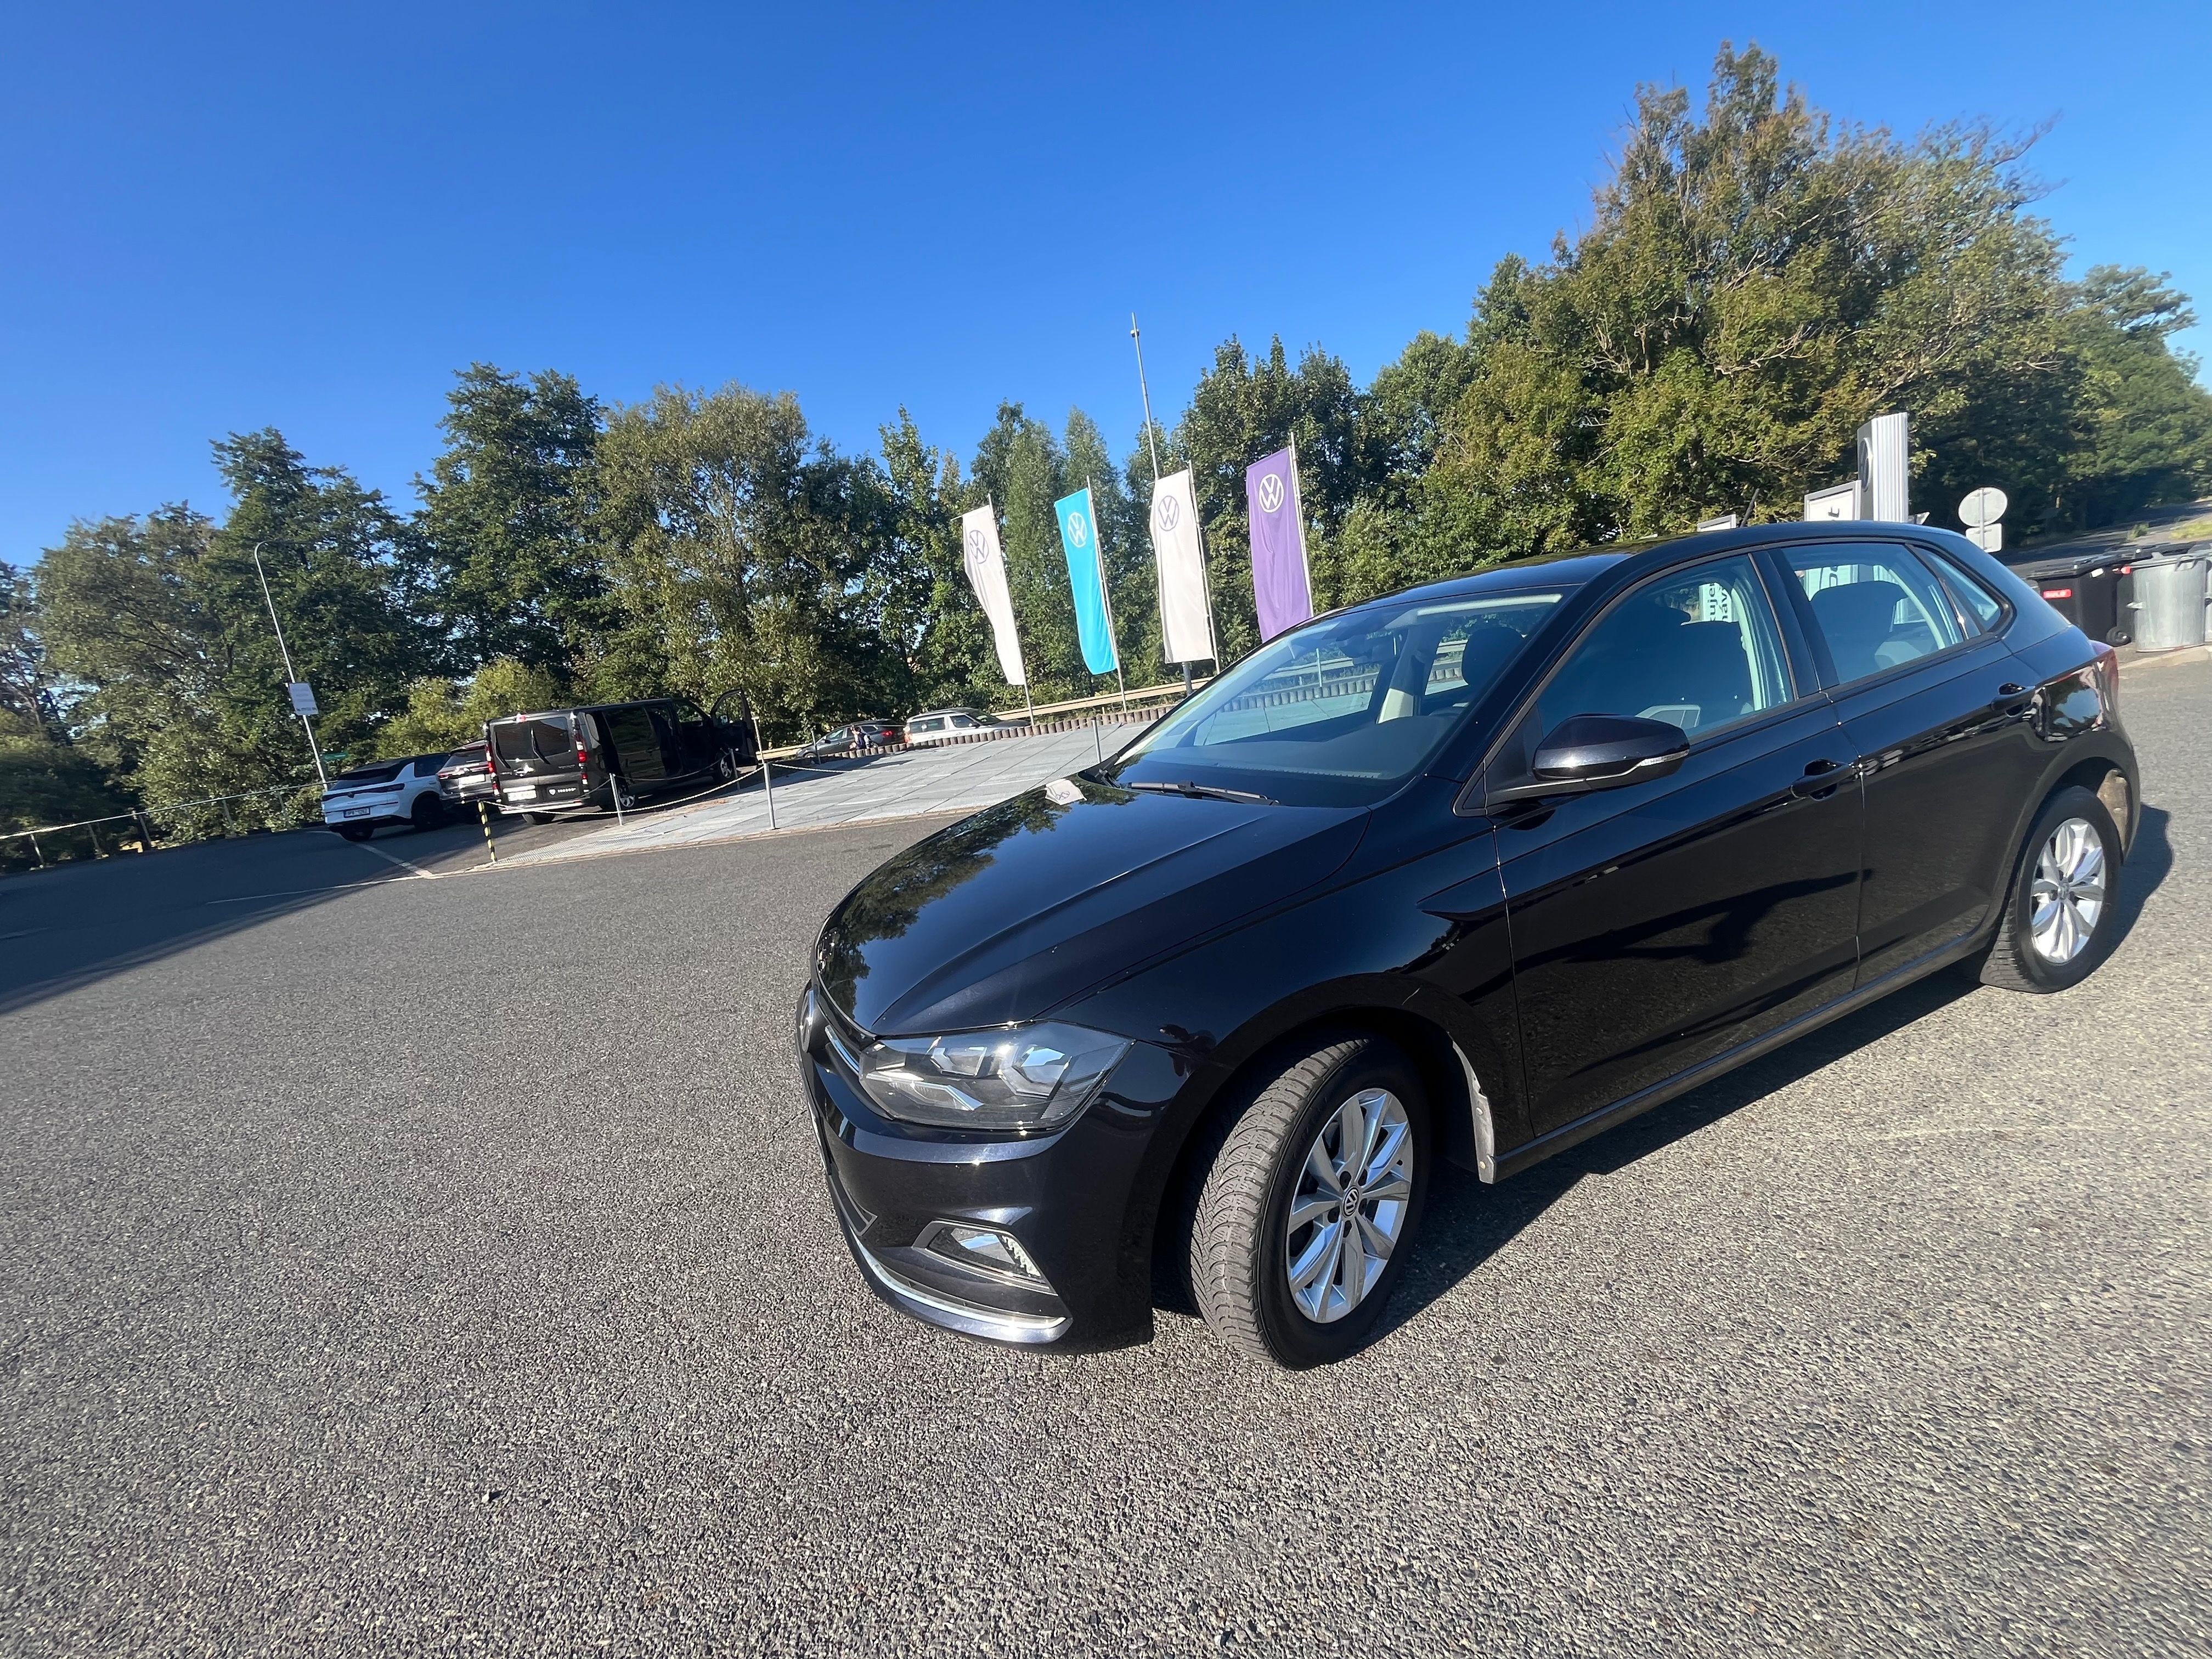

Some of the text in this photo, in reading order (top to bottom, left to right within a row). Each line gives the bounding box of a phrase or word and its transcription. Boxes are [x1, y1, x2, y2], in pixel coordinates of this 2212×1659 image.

[1259, 474, 1284, 513] VW
[1068, 512, 1087, 548] VW
[1159, 495, 1179, 531] VW
